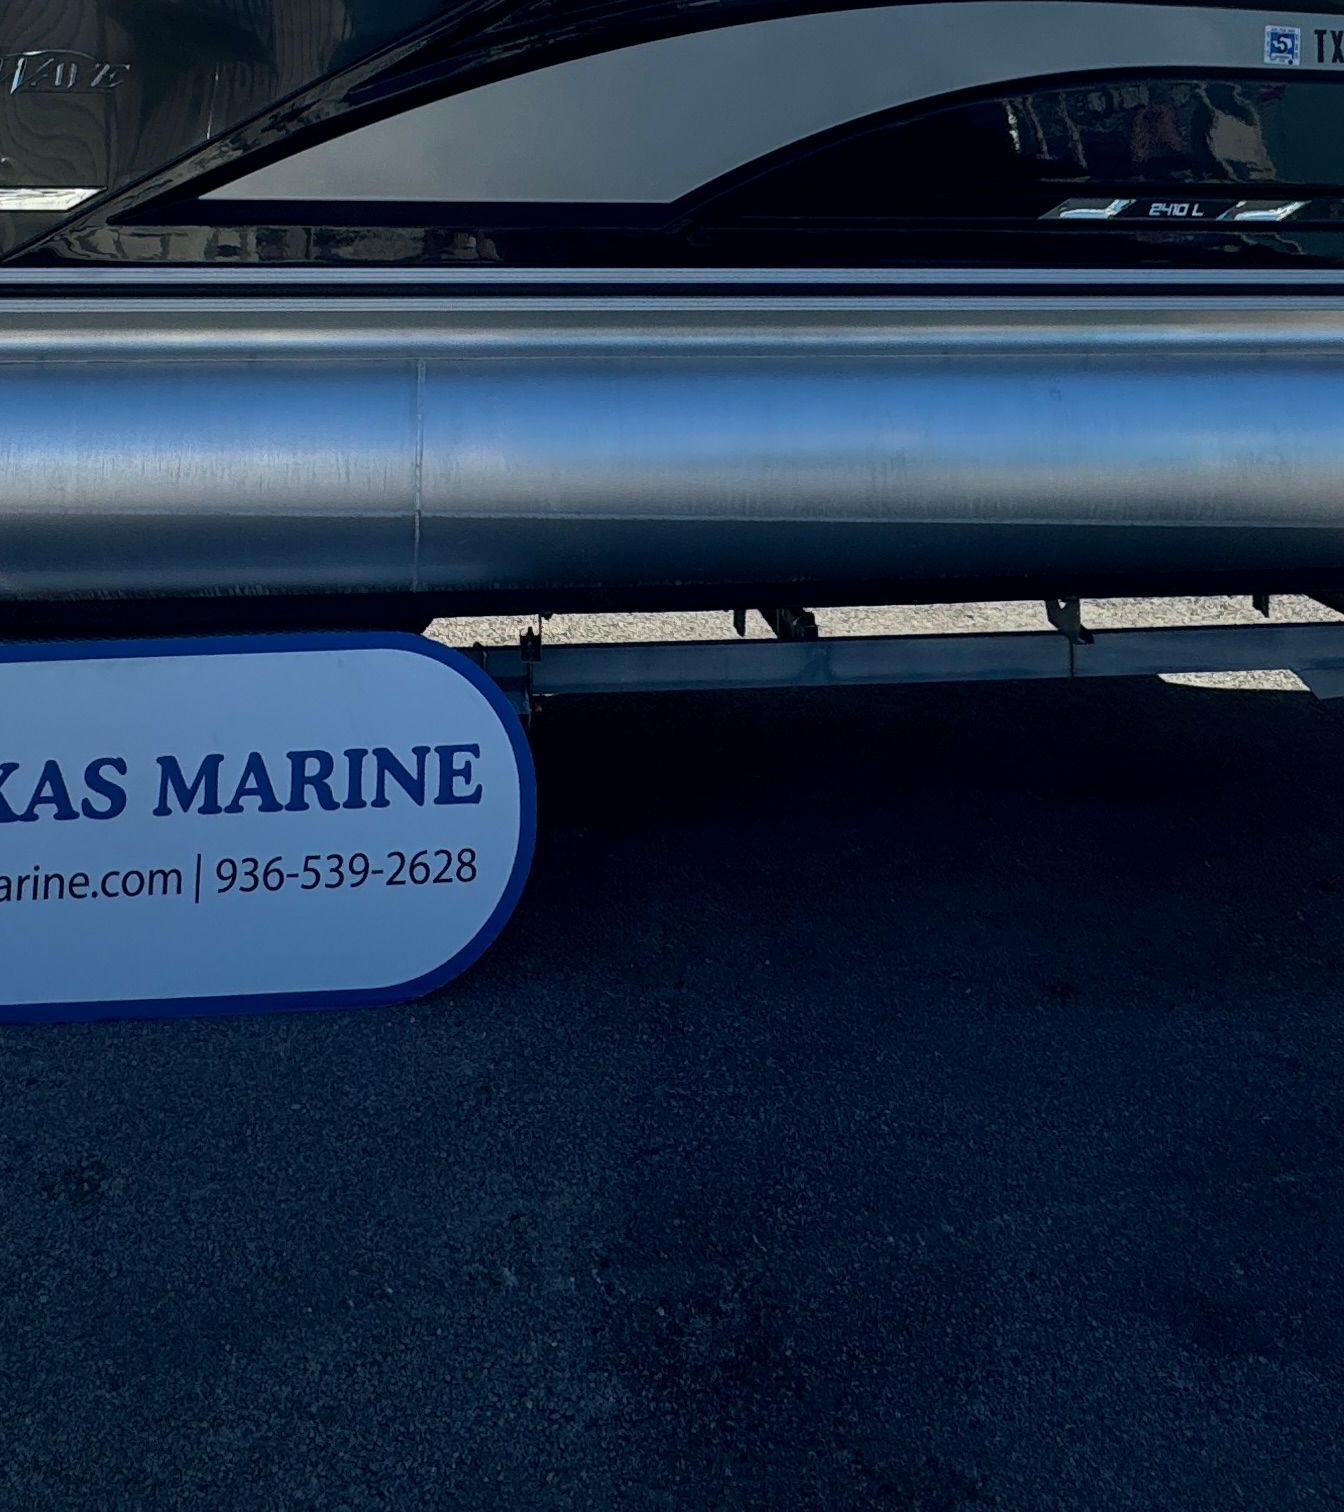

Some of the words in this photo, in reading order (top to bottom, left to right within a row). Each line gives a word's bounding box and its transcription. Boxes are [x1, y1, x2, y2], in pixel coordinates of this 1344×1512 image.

[1149, 203, 1190, 216] 2410
[1191, 203, 1205, 216] L
[152, 743, 483, 817] MARINE
[216, 847, 478, 894] 936-539-2628
